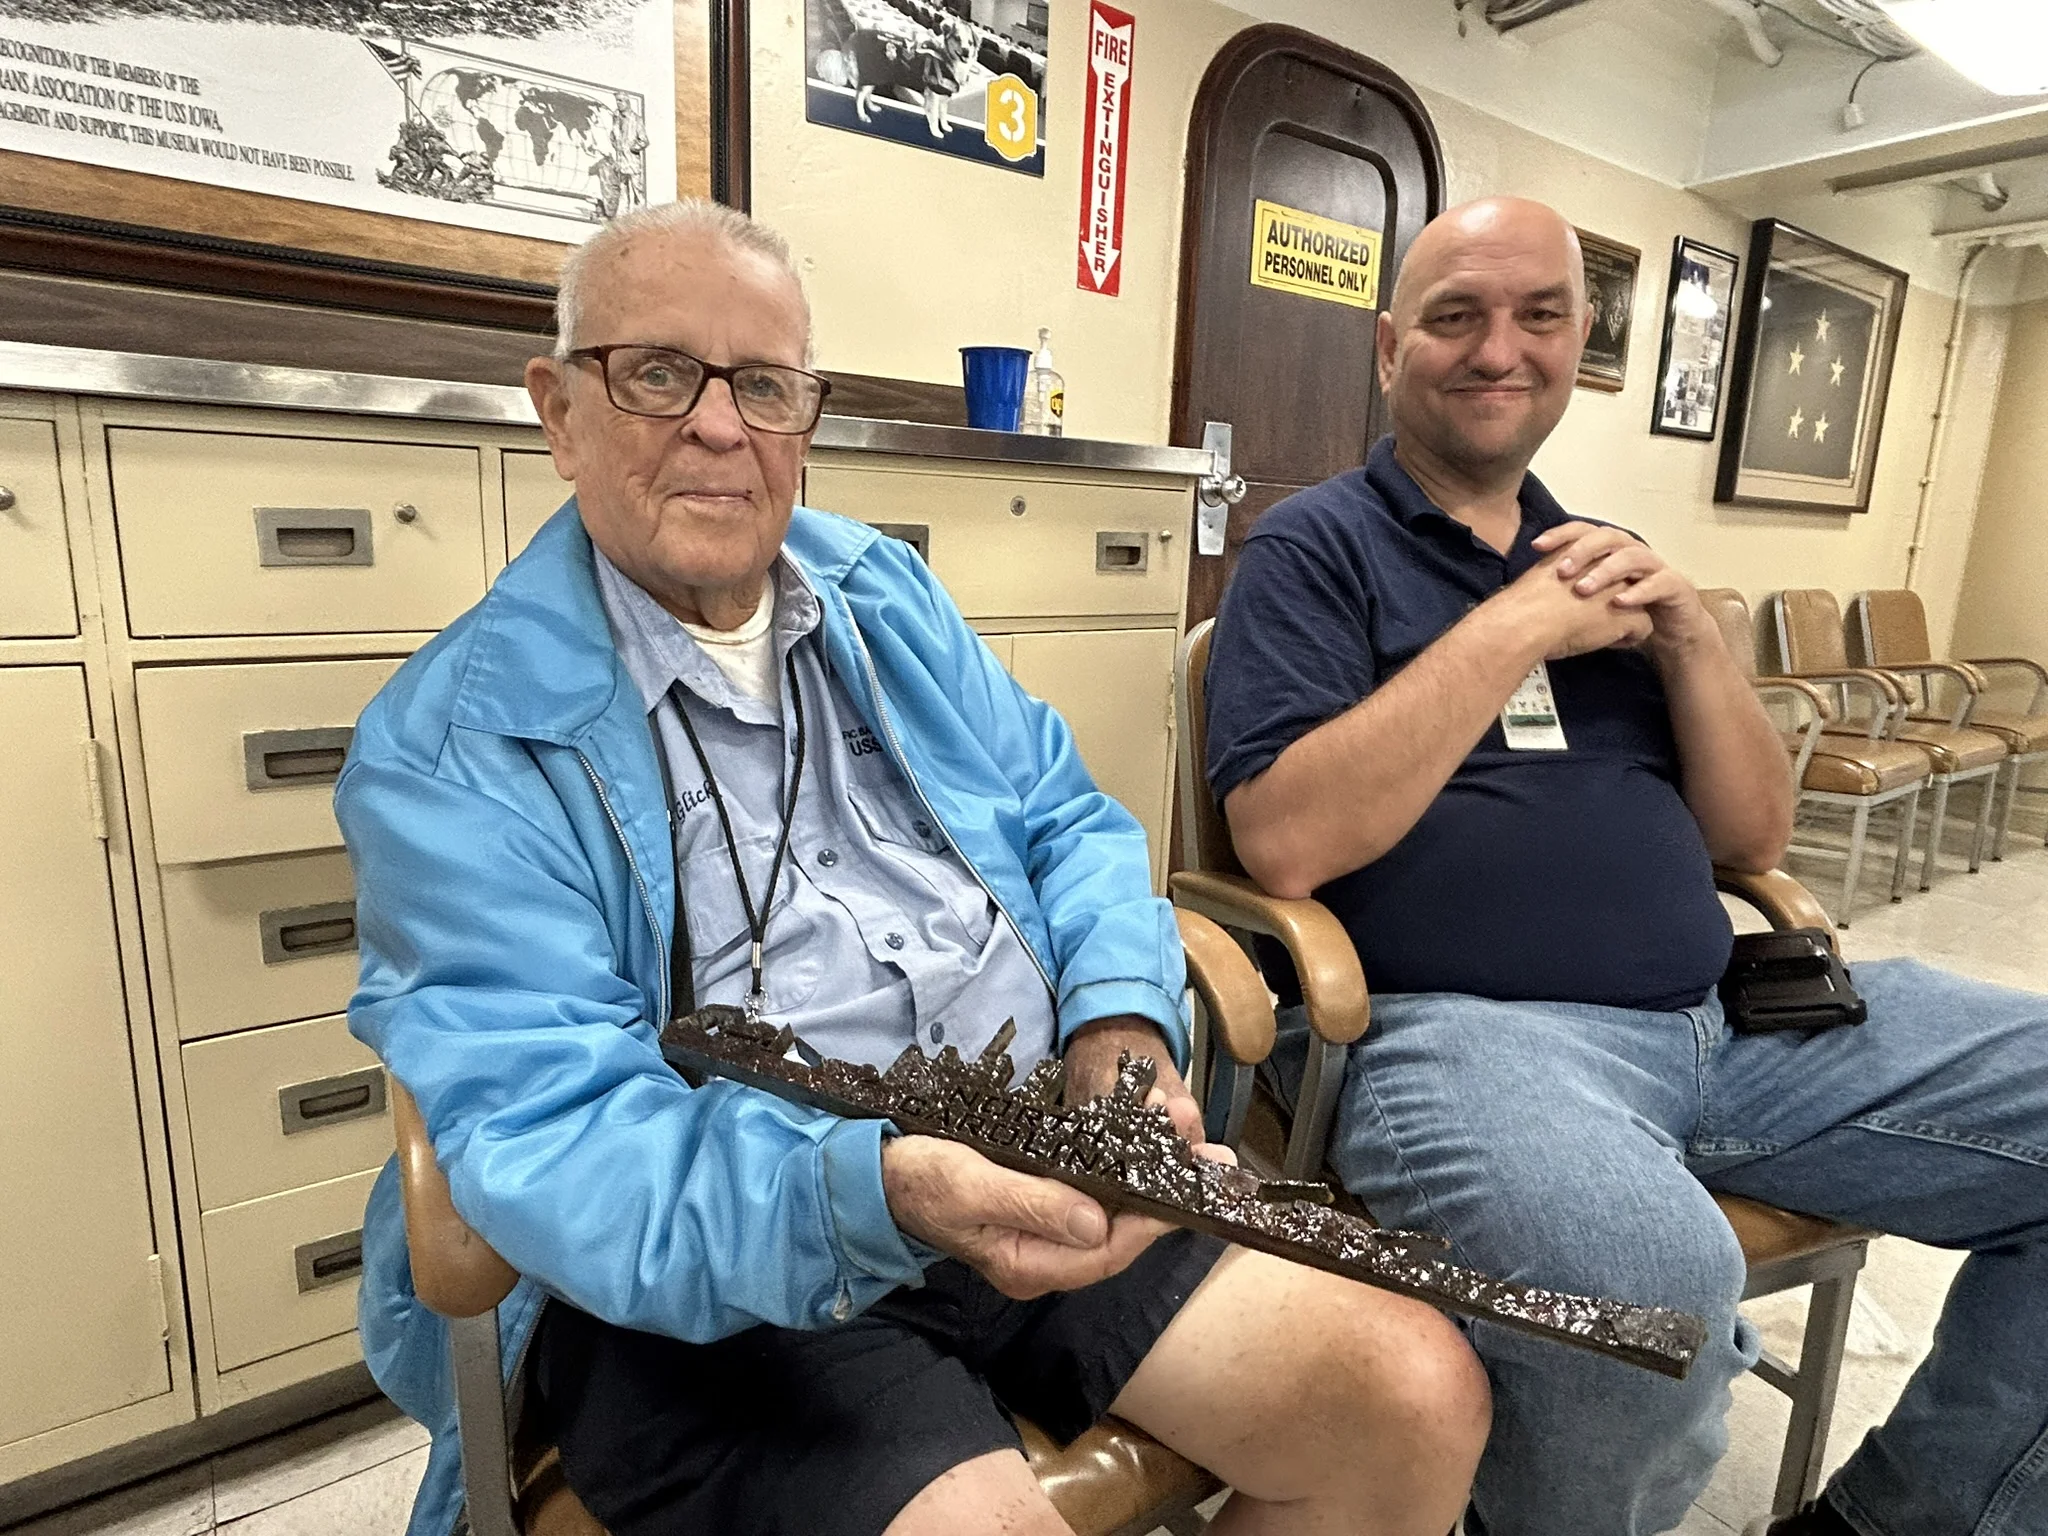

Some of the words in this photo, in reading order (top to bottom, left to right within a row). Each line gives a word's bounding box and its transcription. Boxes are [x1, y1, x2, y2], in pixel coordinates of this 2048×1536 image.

[73, 52, 87, 74] OF
[88, 57, 112, 78] THE
[113, 61, 162, 88] MEMBERS
[164, 71, 177, 91] OF
[178, 75, 201, 96] THE
[1094, 29, 1128, 67] FIRE
[31, 74, 115, 110] ASSOCIATION
[118, 91, 135, 114] OF
[137, 95, 162, 119] THE
[163, 100, 187, 124] USS
[188, 104, 224, 133] IOWA,
[998, 88, 1026, 142] 3
[53, 111, 78, 132] AND
[79, 115, 129, 143] SUPPORT,
[129, 125, 154, 146] THIS
[155, 129, 200, 154] MUSEUM
[200, 138, 238, 160] WOULD
[239, 145, 261, 165] NOT
[261, 149, 288, 170] HAVE
[288, 154, 312, 174] BEEN
[313, 158, 355, 181] POSSIBLE.
[1094, 72, 1116, 273] EXTINGUISHER
[1266, 218, 1370, 267] AUTHORIZED
[1264, 250, 1335, 287] PERSONNEL
[1338, 268, 1368, 293] ONLY
[897, 1094, 1129, 1181] CAROLINA
[948, 1086, 1106, 1147] NORTH
